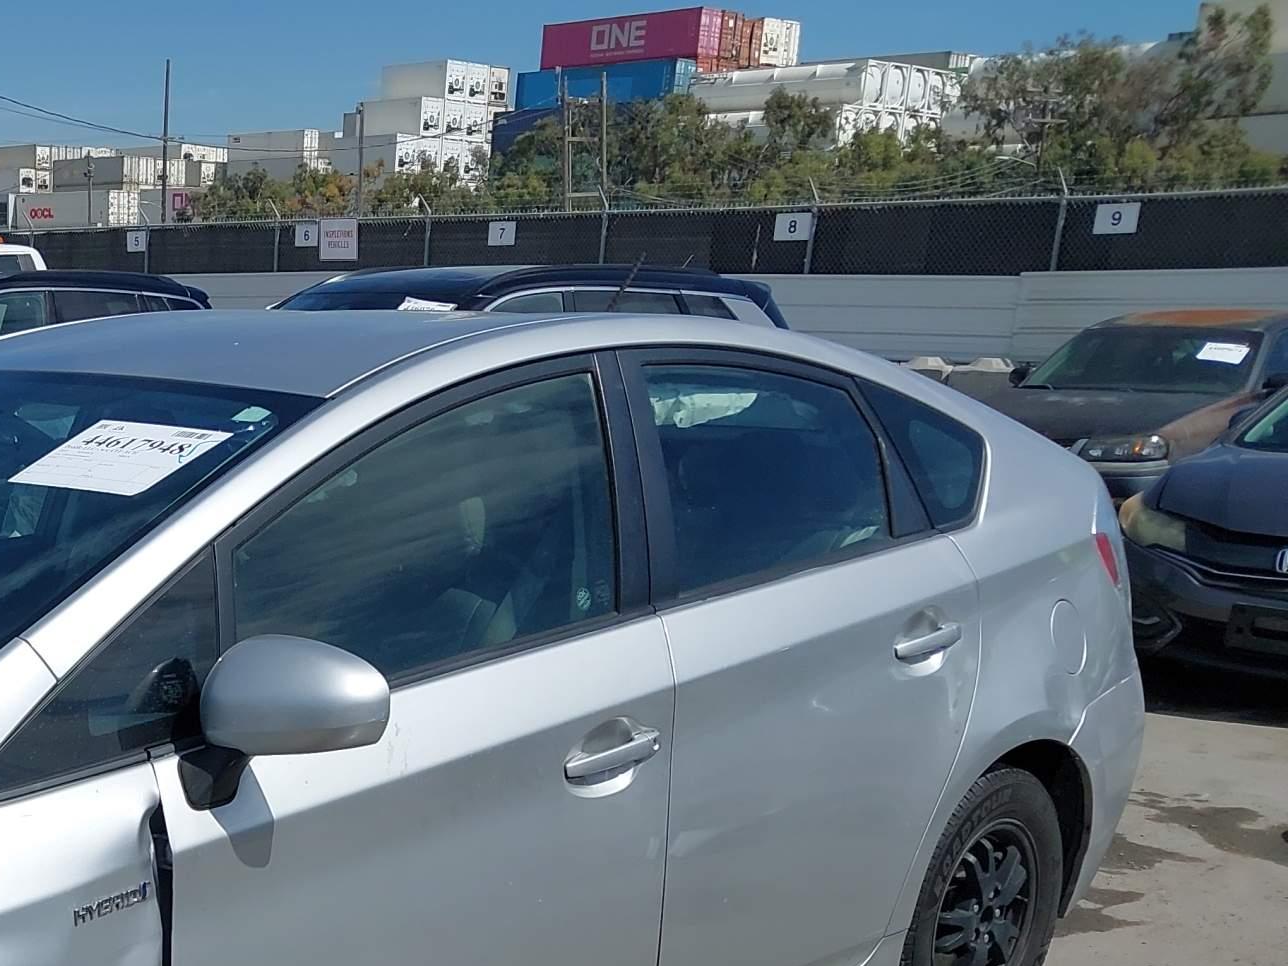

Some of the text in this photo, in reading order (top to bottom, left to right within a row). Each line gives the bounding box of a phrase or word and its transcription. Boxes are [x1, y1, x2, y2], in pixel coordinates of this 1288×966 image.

[591, 20, 647, 50] ONE
[30, 207, 54, 219] OOCL
[1111, 211, 1122, 226] 9
[788, 220, 797, 233] 8
[303, 230, 310, 241] 6
[499, 227, 506, 240] 7
[134, 236, 140, 247] 5
[81, 434, 192, 455] 44617948
